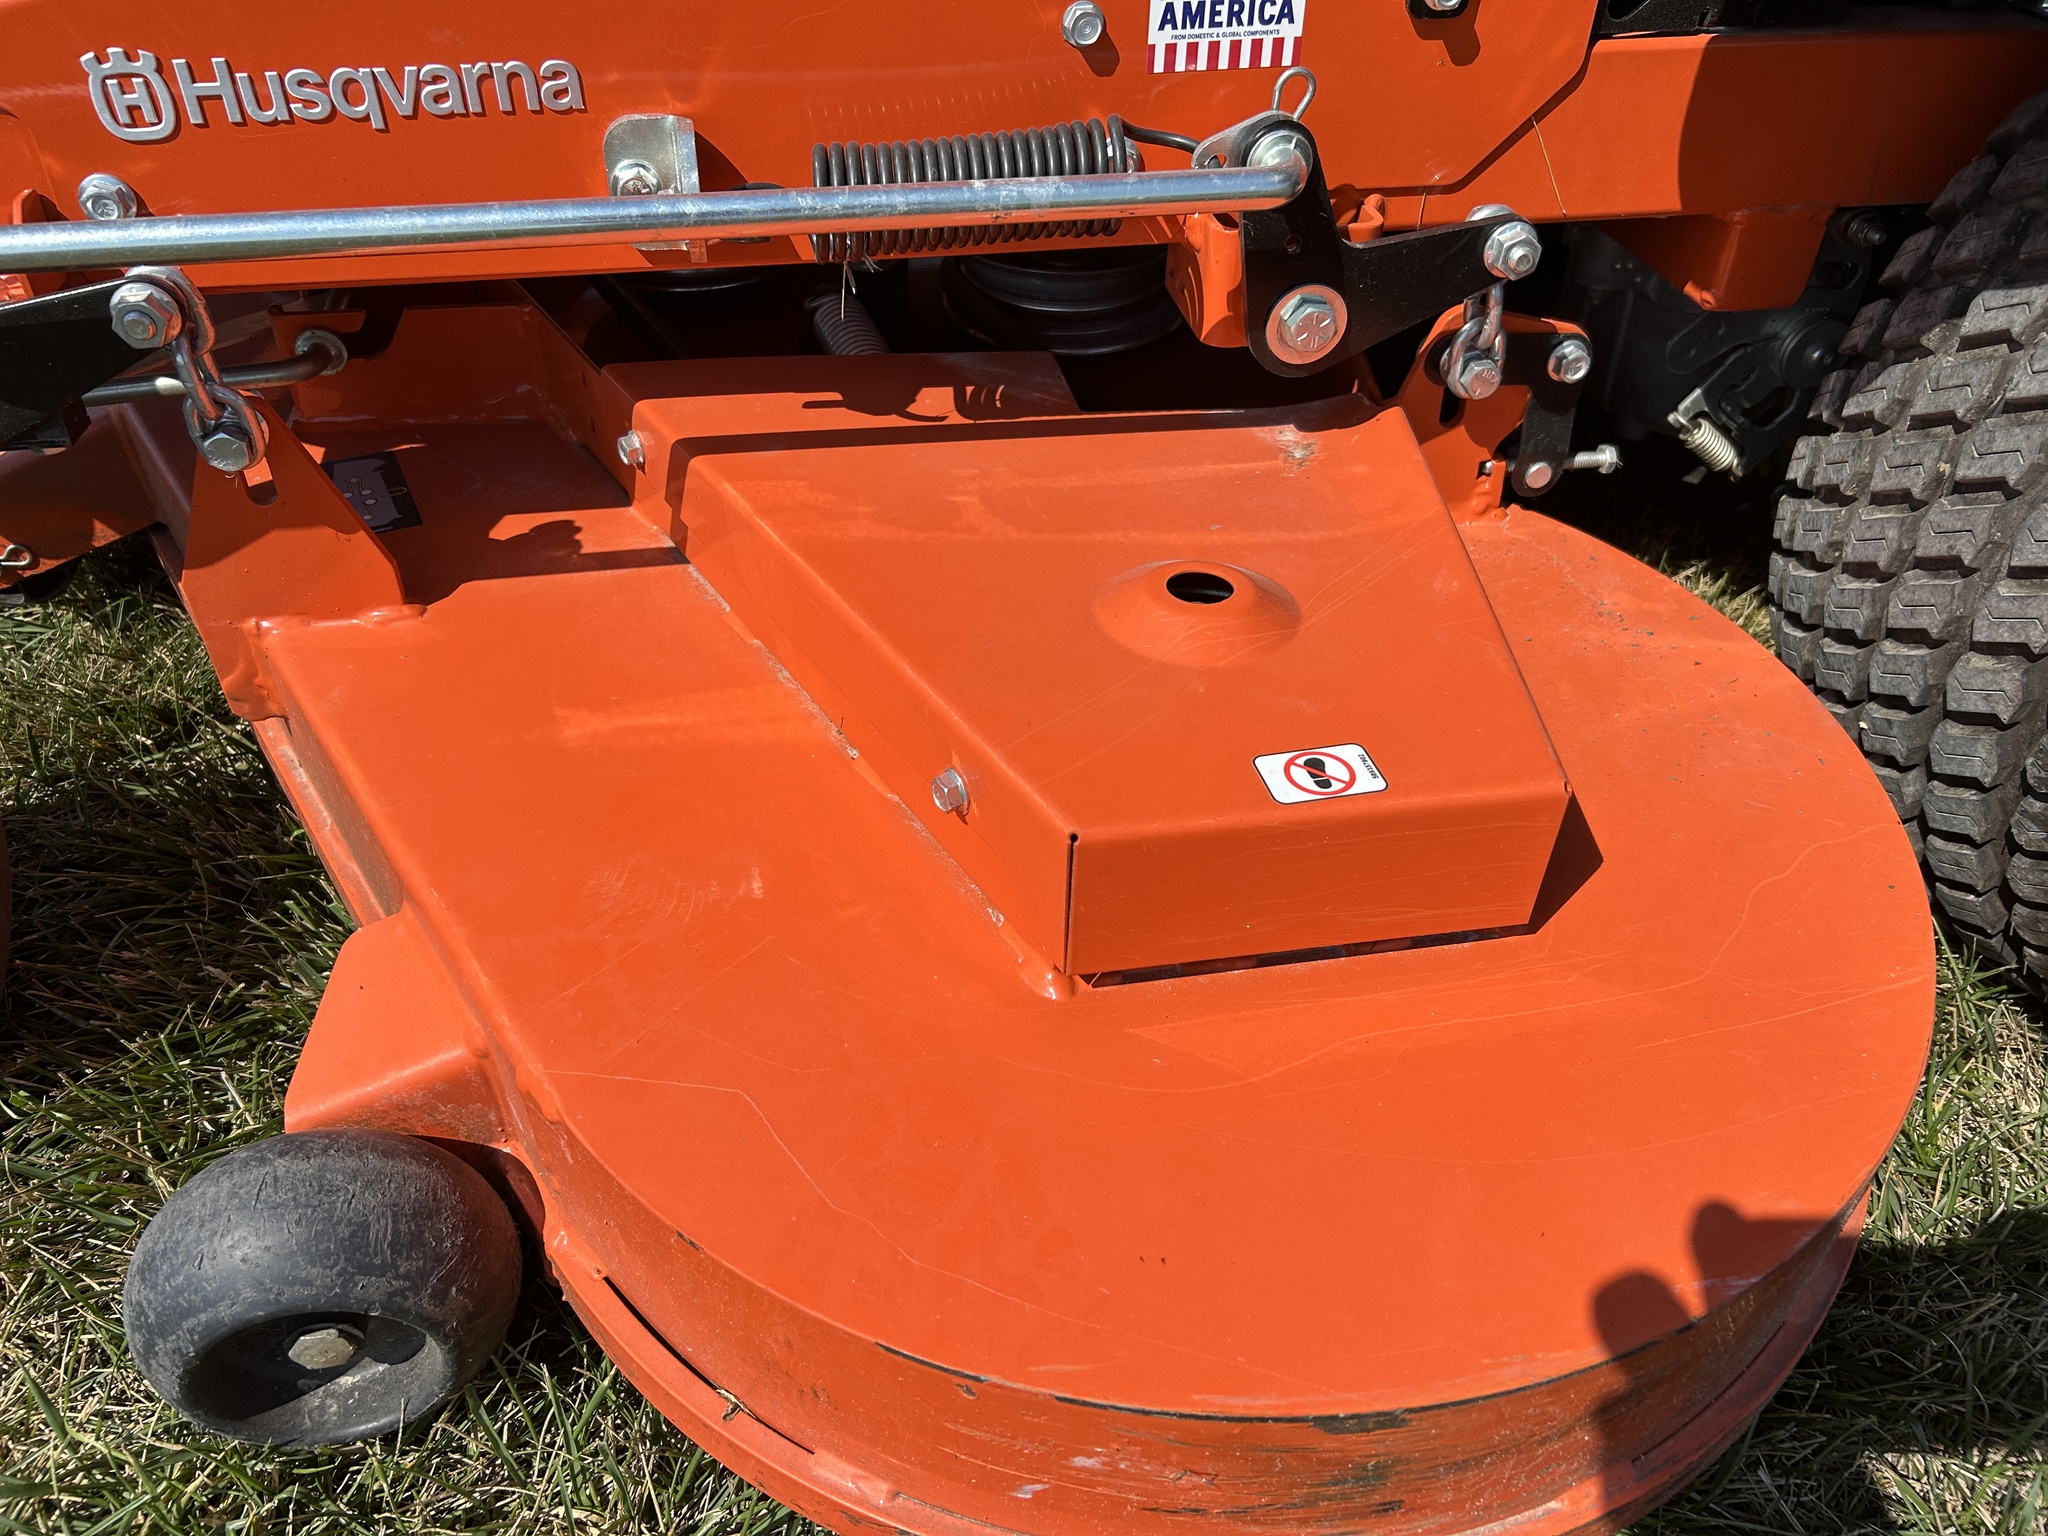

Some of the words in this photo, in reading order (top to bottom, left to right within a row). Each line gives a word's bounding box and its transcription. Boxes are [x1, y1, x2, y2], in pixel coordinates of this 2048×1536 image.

[1158, 0, 1295, 31] AMERICA
[1187, 32, 1215, 40] DOMESTIC
[1243, 29, 1280, 37] COMPONENTS
[171, 57, 586, 131] Husqvarna
